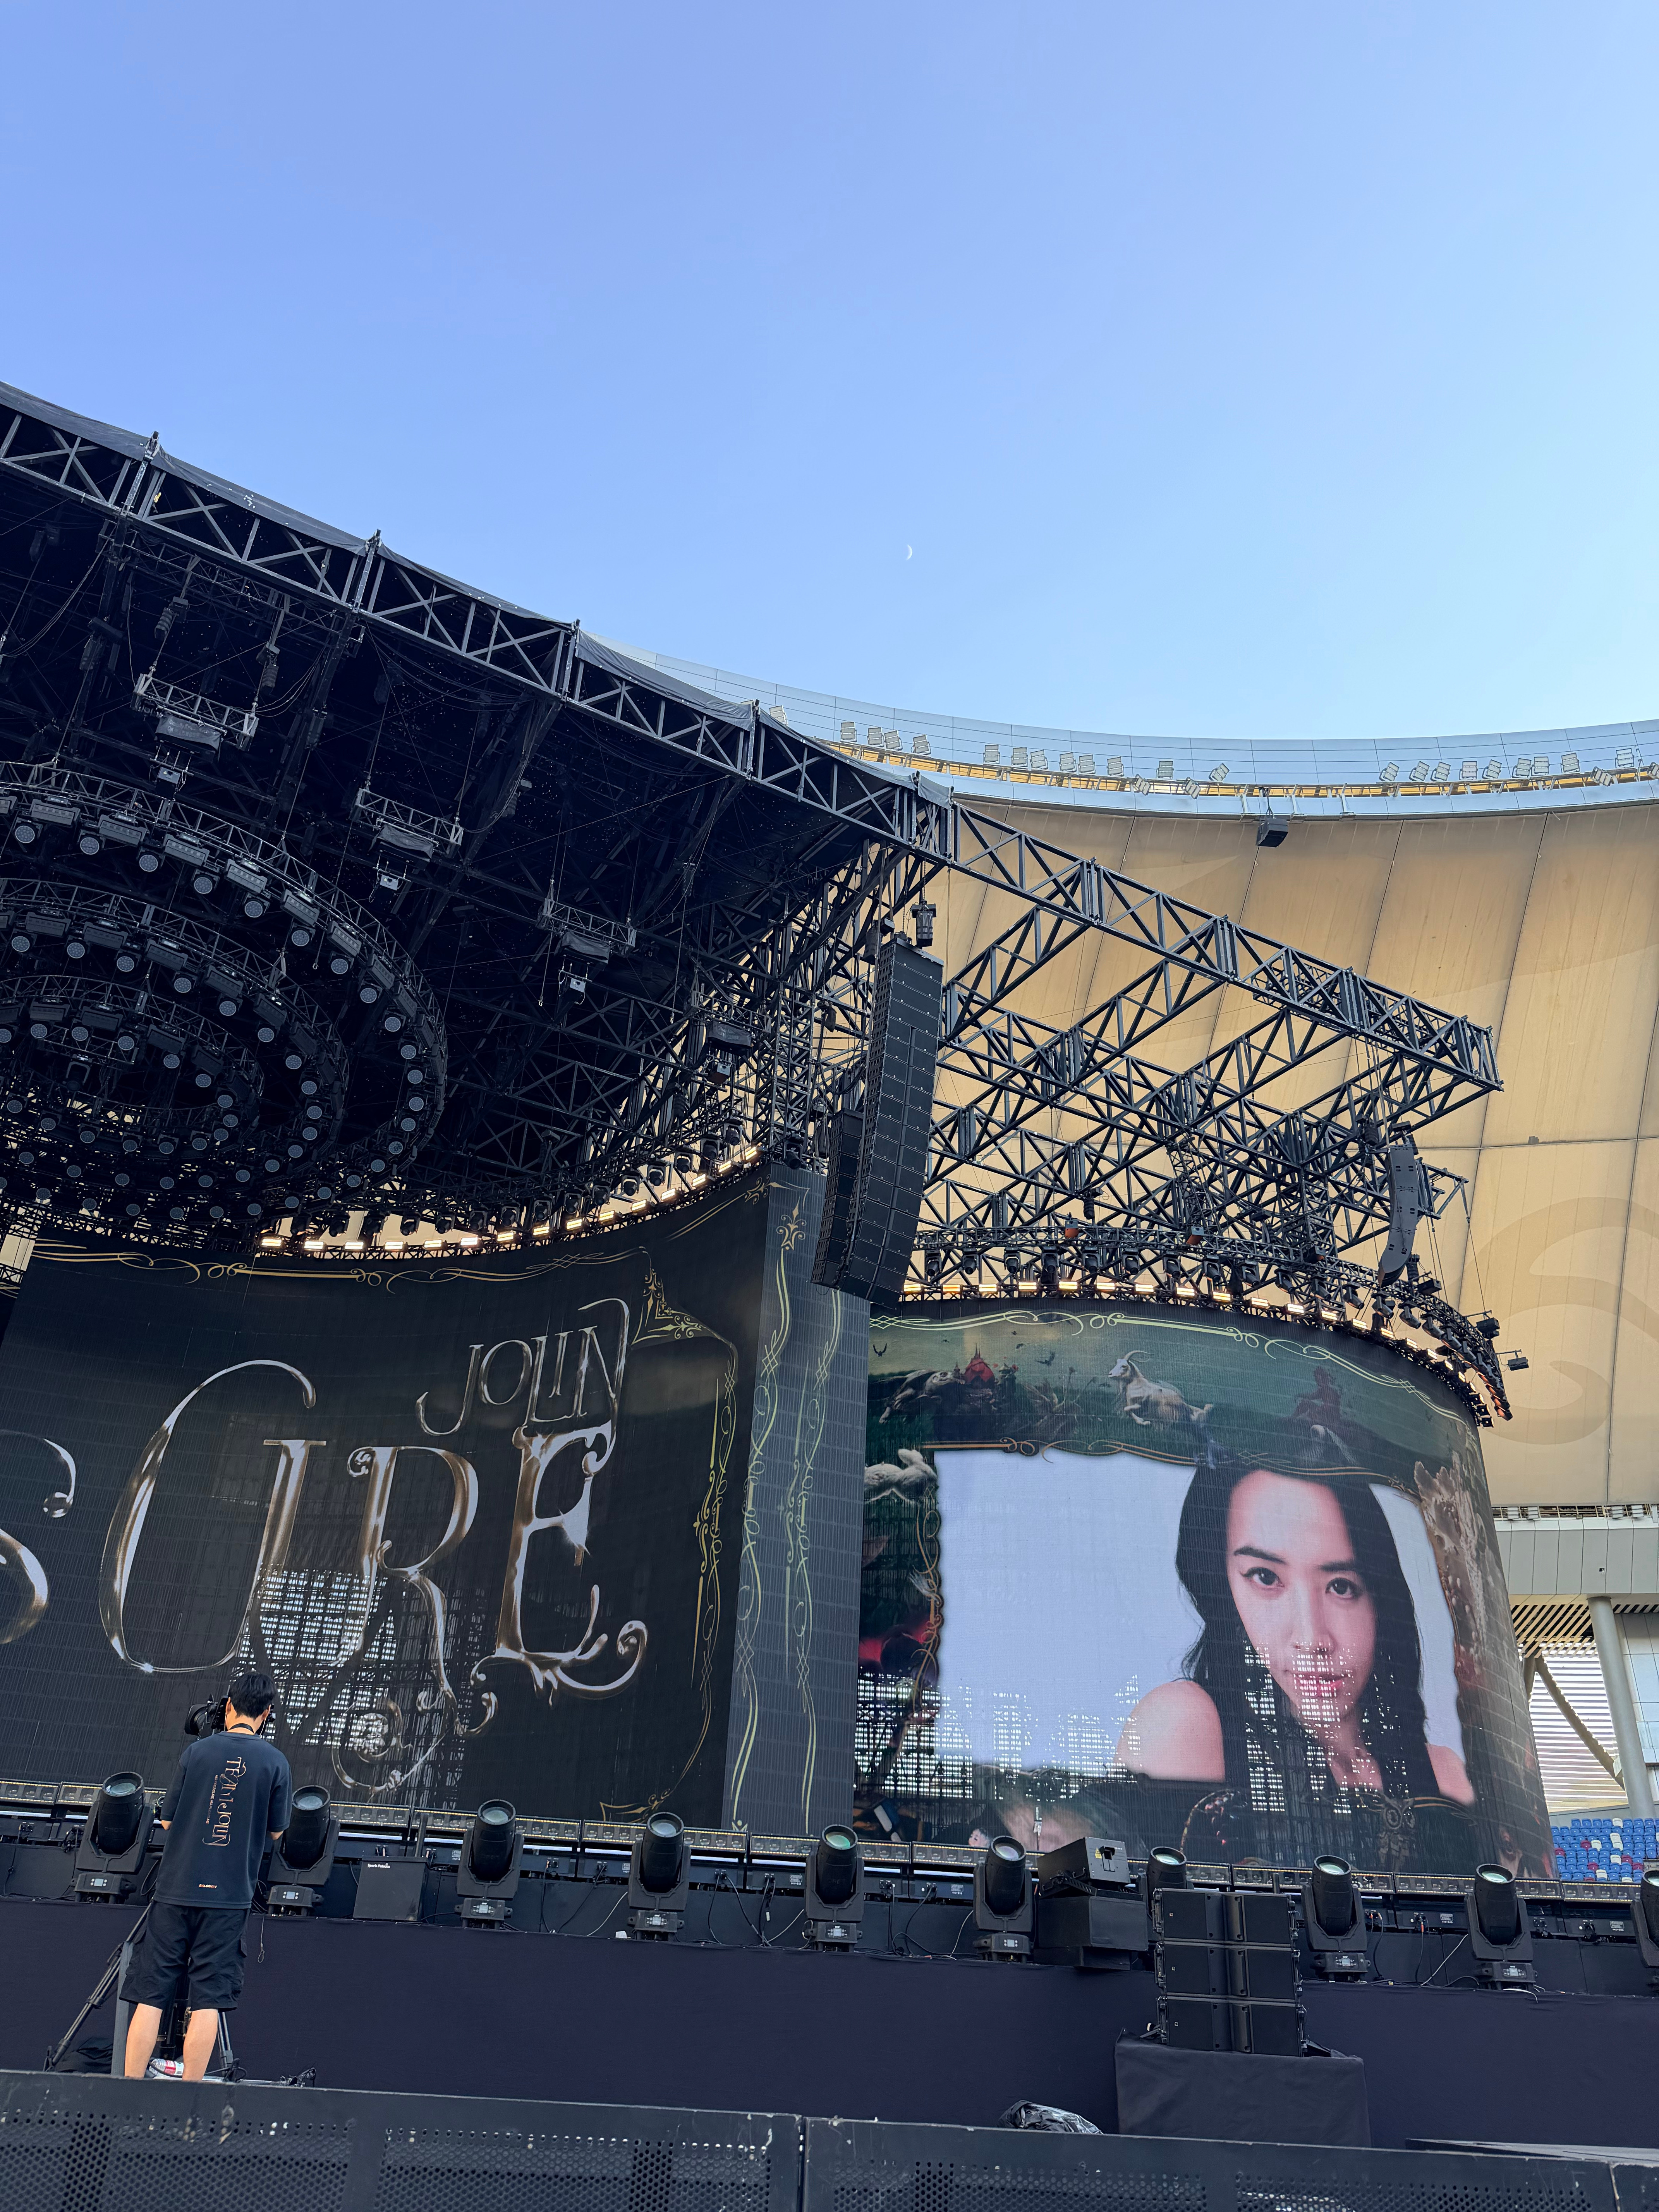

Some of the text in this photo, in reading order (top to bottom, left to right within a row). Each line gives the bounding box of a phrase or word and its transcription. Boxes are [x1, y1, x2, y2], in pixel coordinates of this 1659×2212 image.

[416, 1297, 630, 1436] JOLIN
[202, 1757, 246, 1846] TEAM JOLIN
